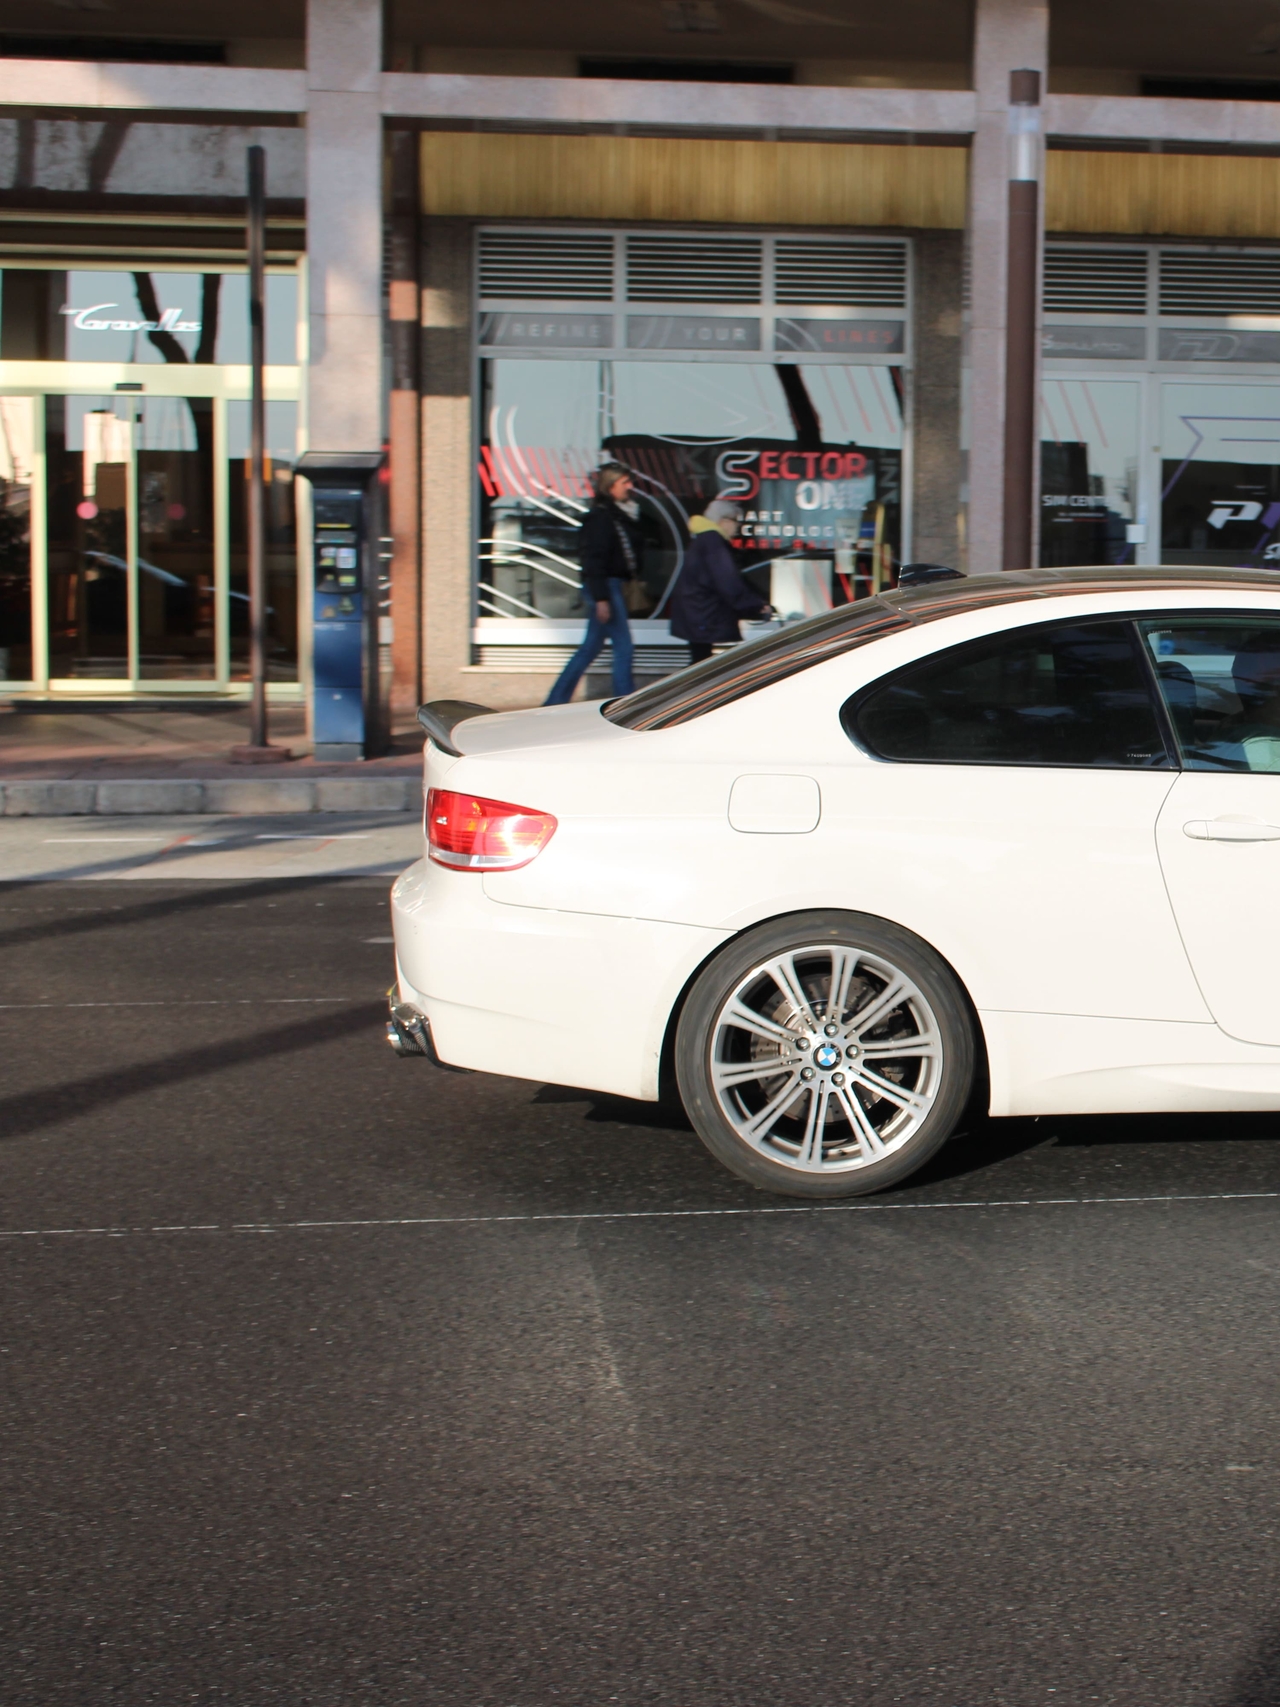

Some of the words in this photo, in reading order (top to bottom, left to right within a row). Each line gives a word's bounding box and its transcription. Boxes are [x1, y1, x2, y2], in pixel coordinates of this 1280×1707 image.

[511, 322, 600, 339] REFINE
[682, 327, 747, 342] YOUR
[823, 329, 895, 344] LINES
[715, 451, 868, 500] SECTOR
[796, 480, 867, 511] ONE
